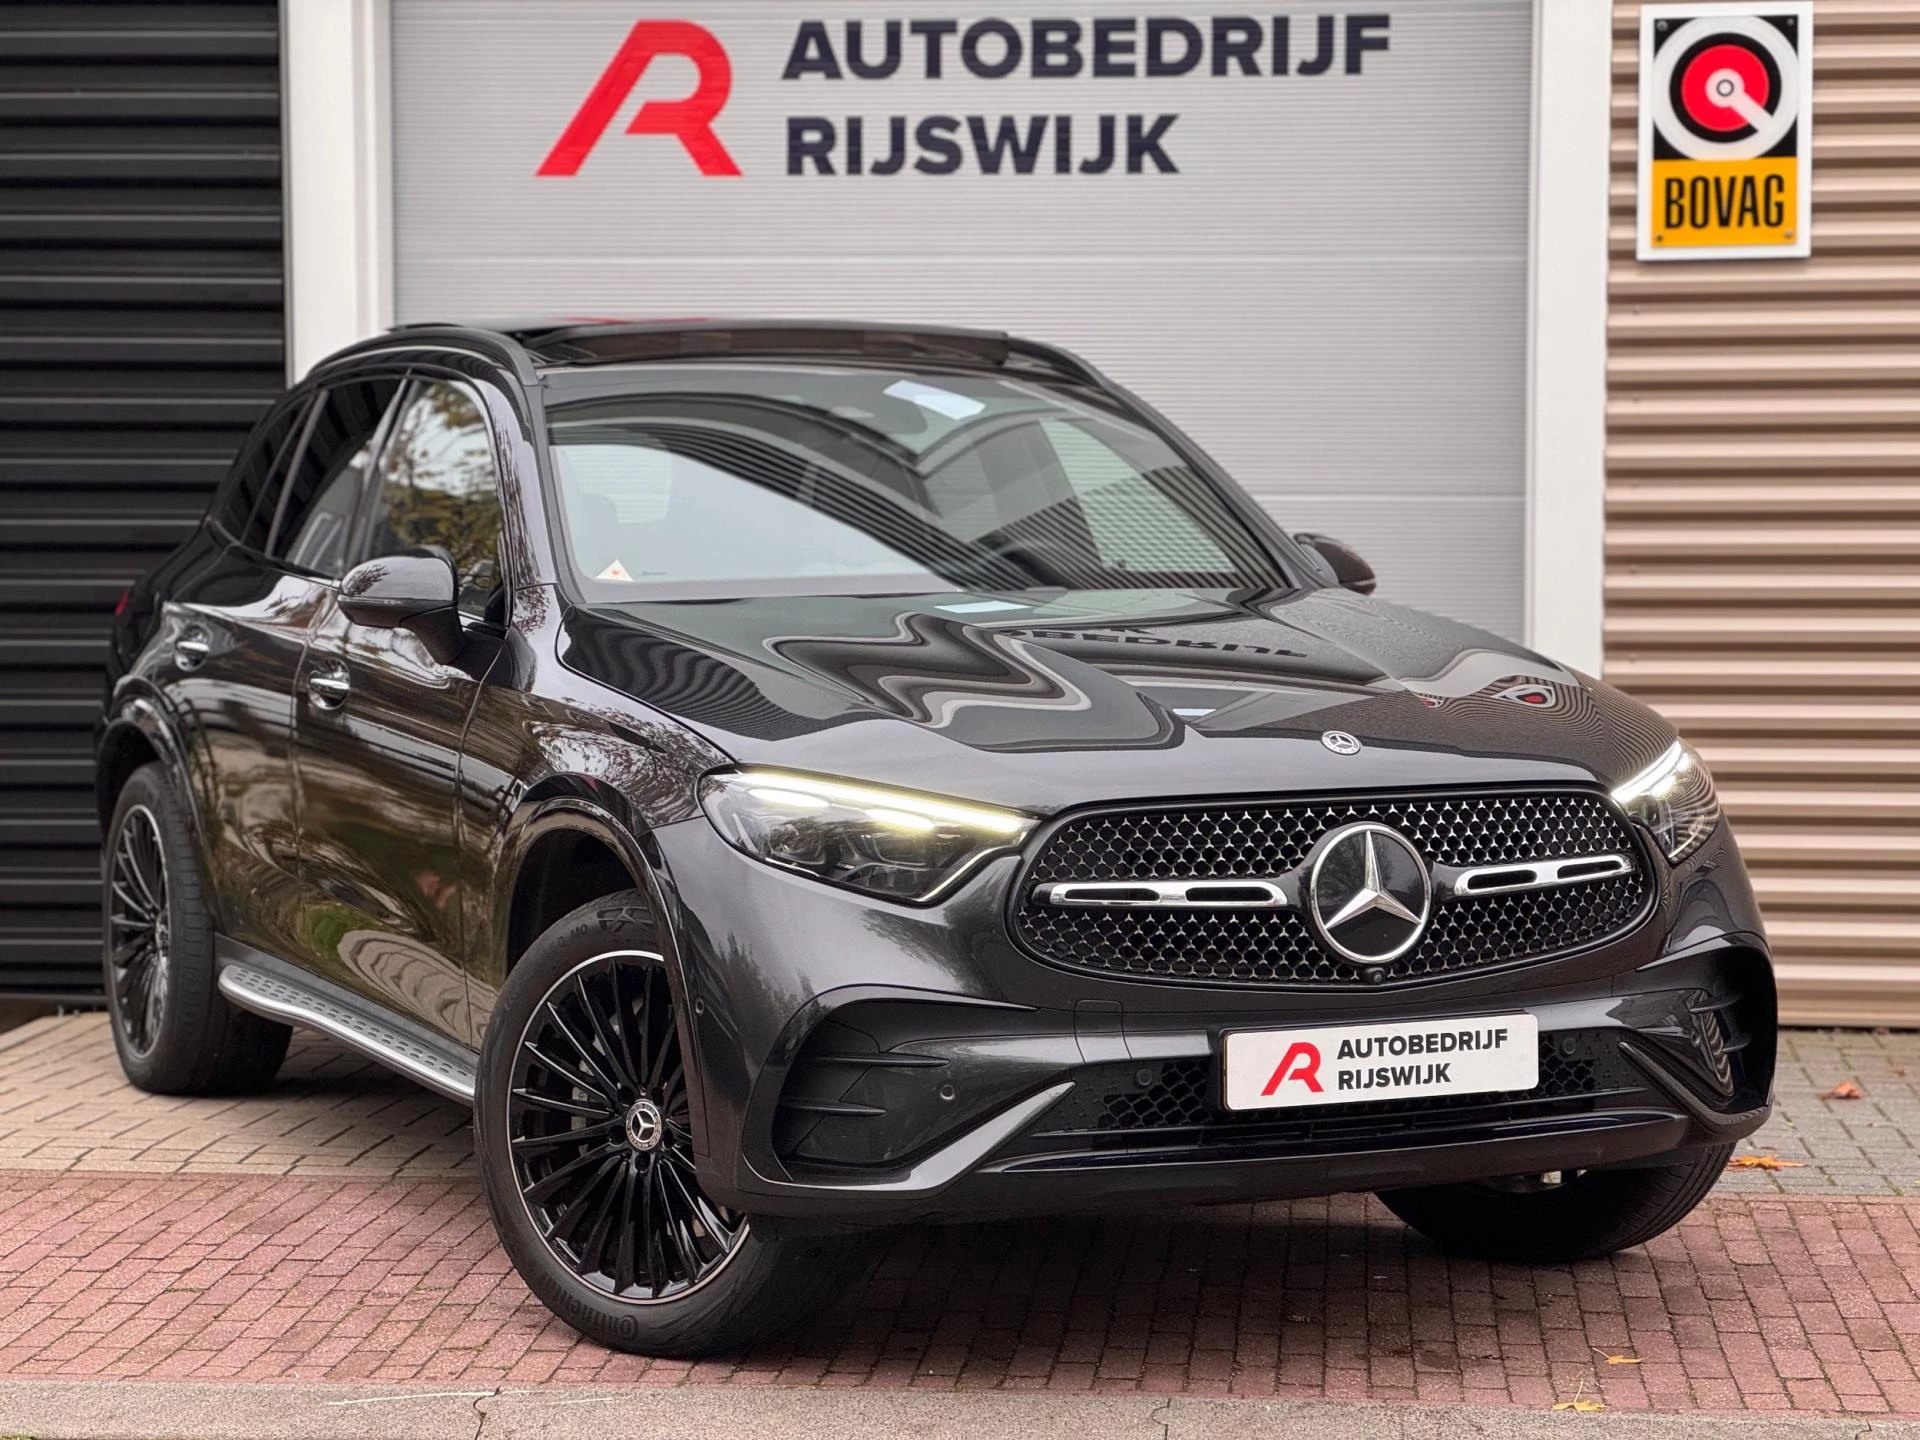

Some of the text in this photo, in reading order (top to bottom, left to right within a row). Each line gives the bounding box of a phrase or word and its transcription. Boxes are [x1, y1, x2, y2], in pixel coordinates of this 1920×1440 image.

[782, 14, 1391, 80] AUTOBEDRIJF
[787, 114, 1179, 176] RIJSWIJK
[1664, 174, 1785, 229] BOVAG
[1337, 1028, 1508, 1060] AUTOBEDRIJF
[1338, 1062, 1451, 1091] RIJSWIJK
